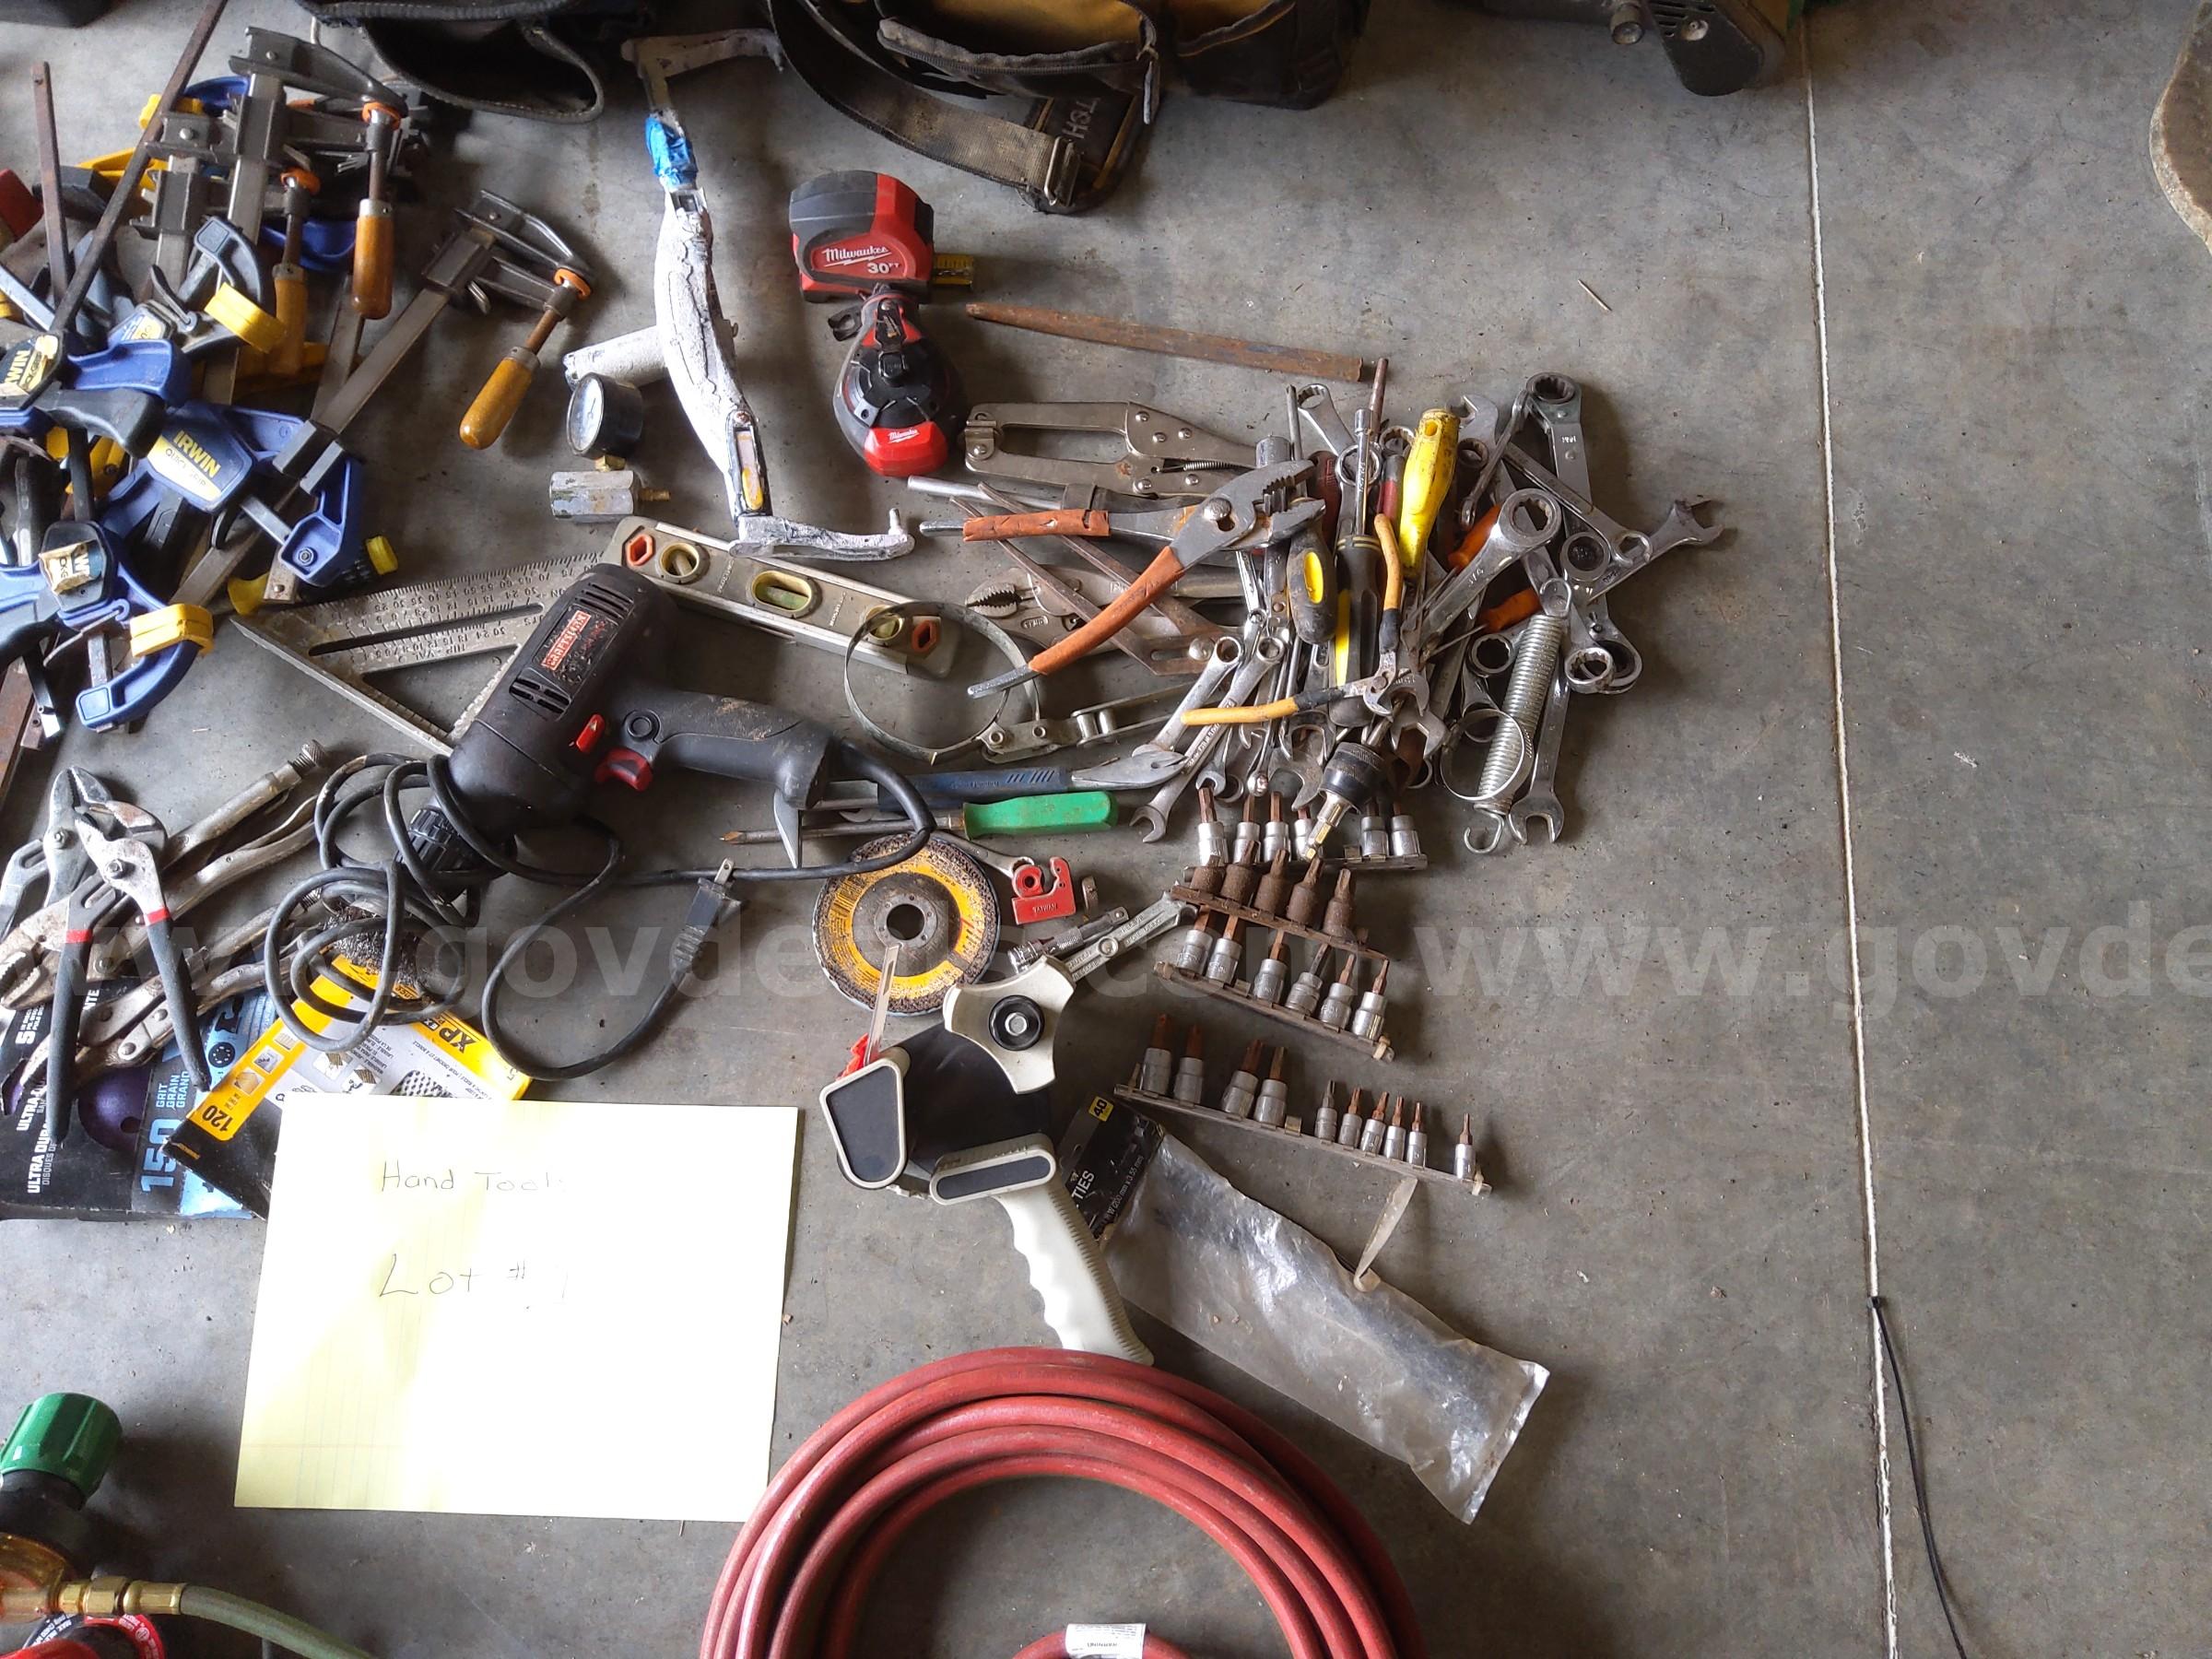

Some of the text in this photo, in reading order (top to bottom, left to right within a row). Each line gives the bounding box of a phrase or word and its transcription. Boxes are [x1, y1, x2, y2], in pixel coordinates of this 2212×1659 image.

[822, 245, 891, 264] Milwaukee
[4, 350, 29, 381] WIN
[173, 429, 221, 478] IRWIN
[15, 1030, 35, 1043] 5
[439, 1030, 477, 1053] XP
[155, 1082, 168, 1107] GRIT
[165, 1074, 180, 1107] GRAIN
[200, 1102, 234, 1134] 120
[1092, 1098, 1108, 1117] 40
[41, 1152, 53, 1184] DISQUES
[138, 1116, 183, 1193] 150
[28, 1154, 44, 1193] ULTRA
[382, 1159, 564, 1193] Hand Tool
[1070, 1169, 1096, 1201] TIES
[379, 1253, 482, 1297] Lot
